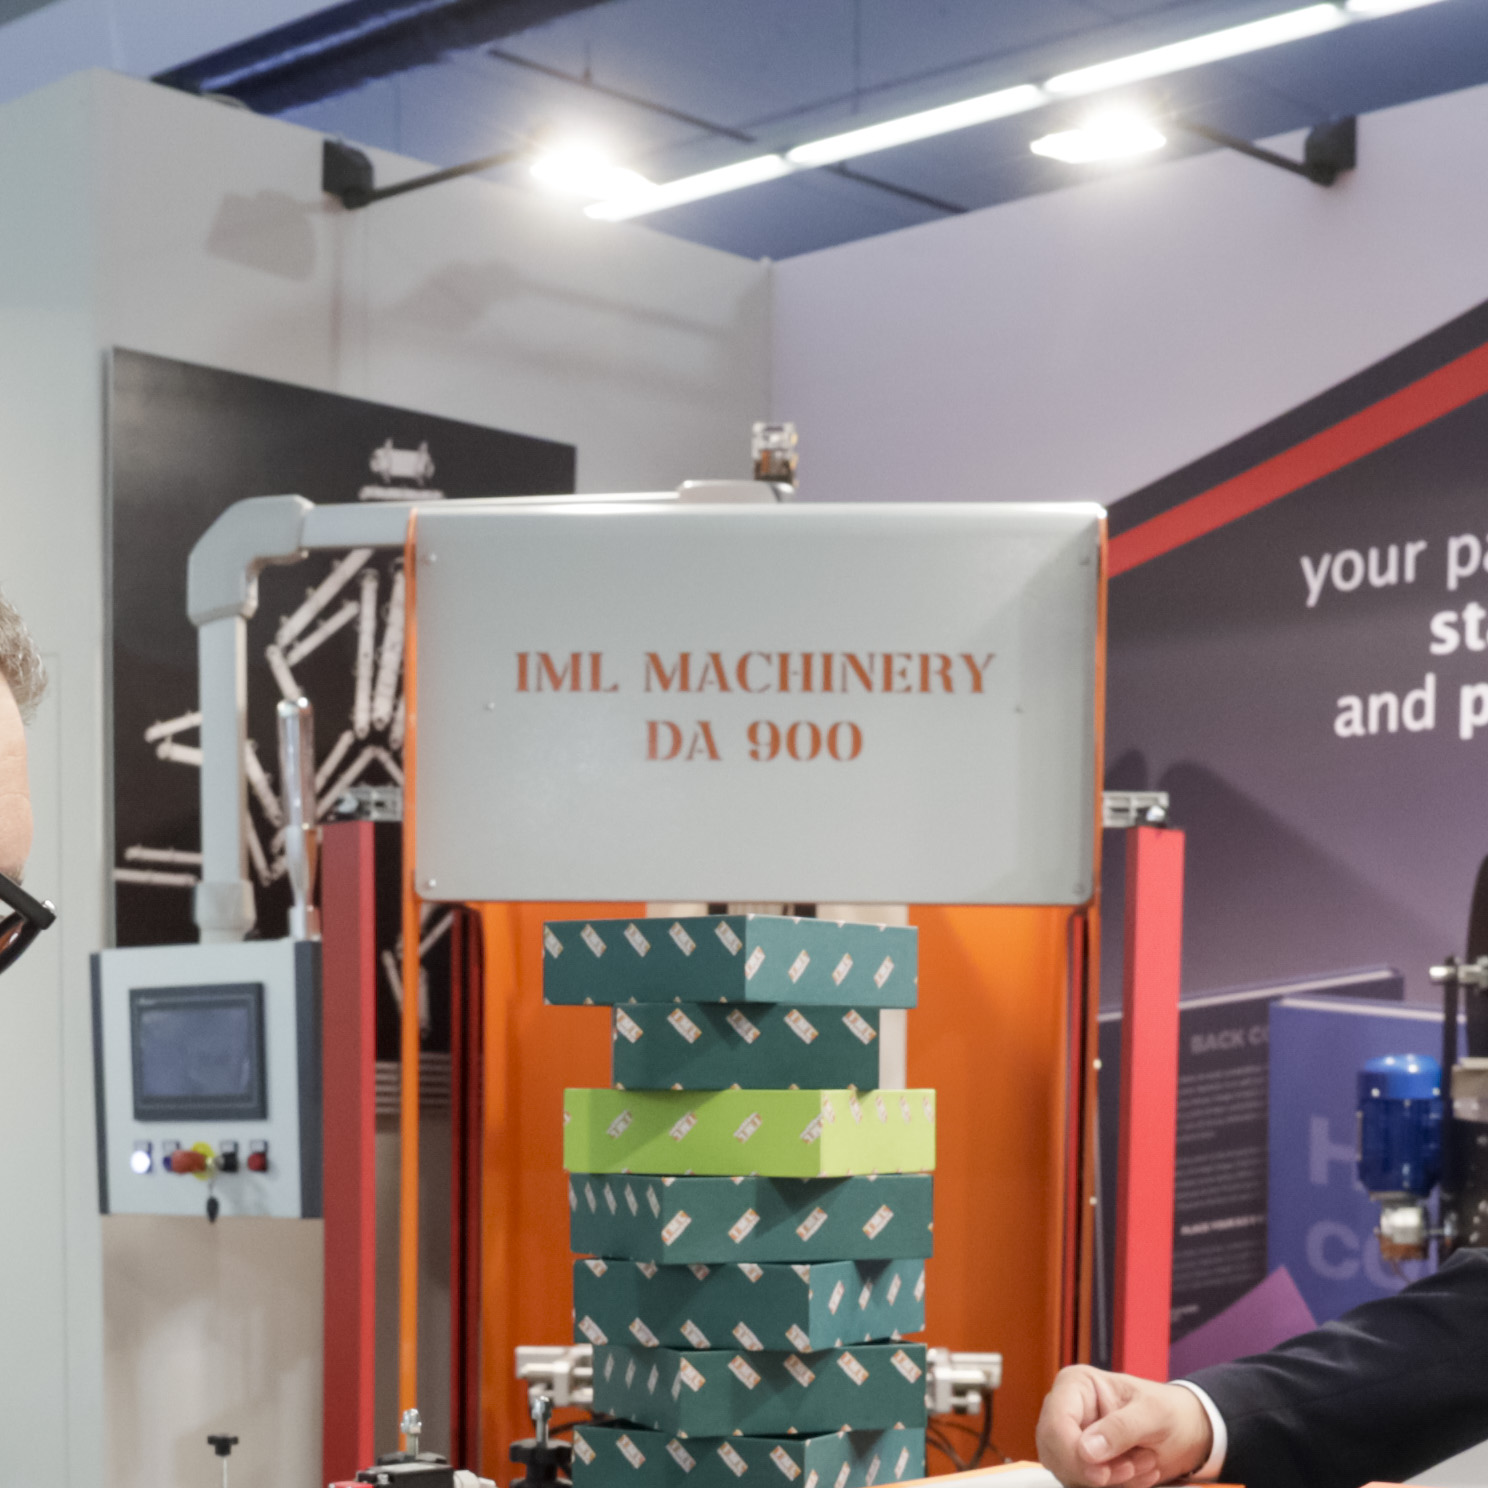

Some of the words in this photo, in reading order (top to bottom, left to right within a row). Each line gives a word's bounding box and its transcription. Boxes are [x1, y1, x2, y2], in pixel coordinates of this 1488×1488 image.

[1301, 533, 1429, 606] your
[515, 651, 619, 694] IML
[643, 651, 998, 694] MACHINERY
[1333, 672, 1437, 738] and
[644, 719, 723, 763] DA
[746, 719, 864, 762] 900
